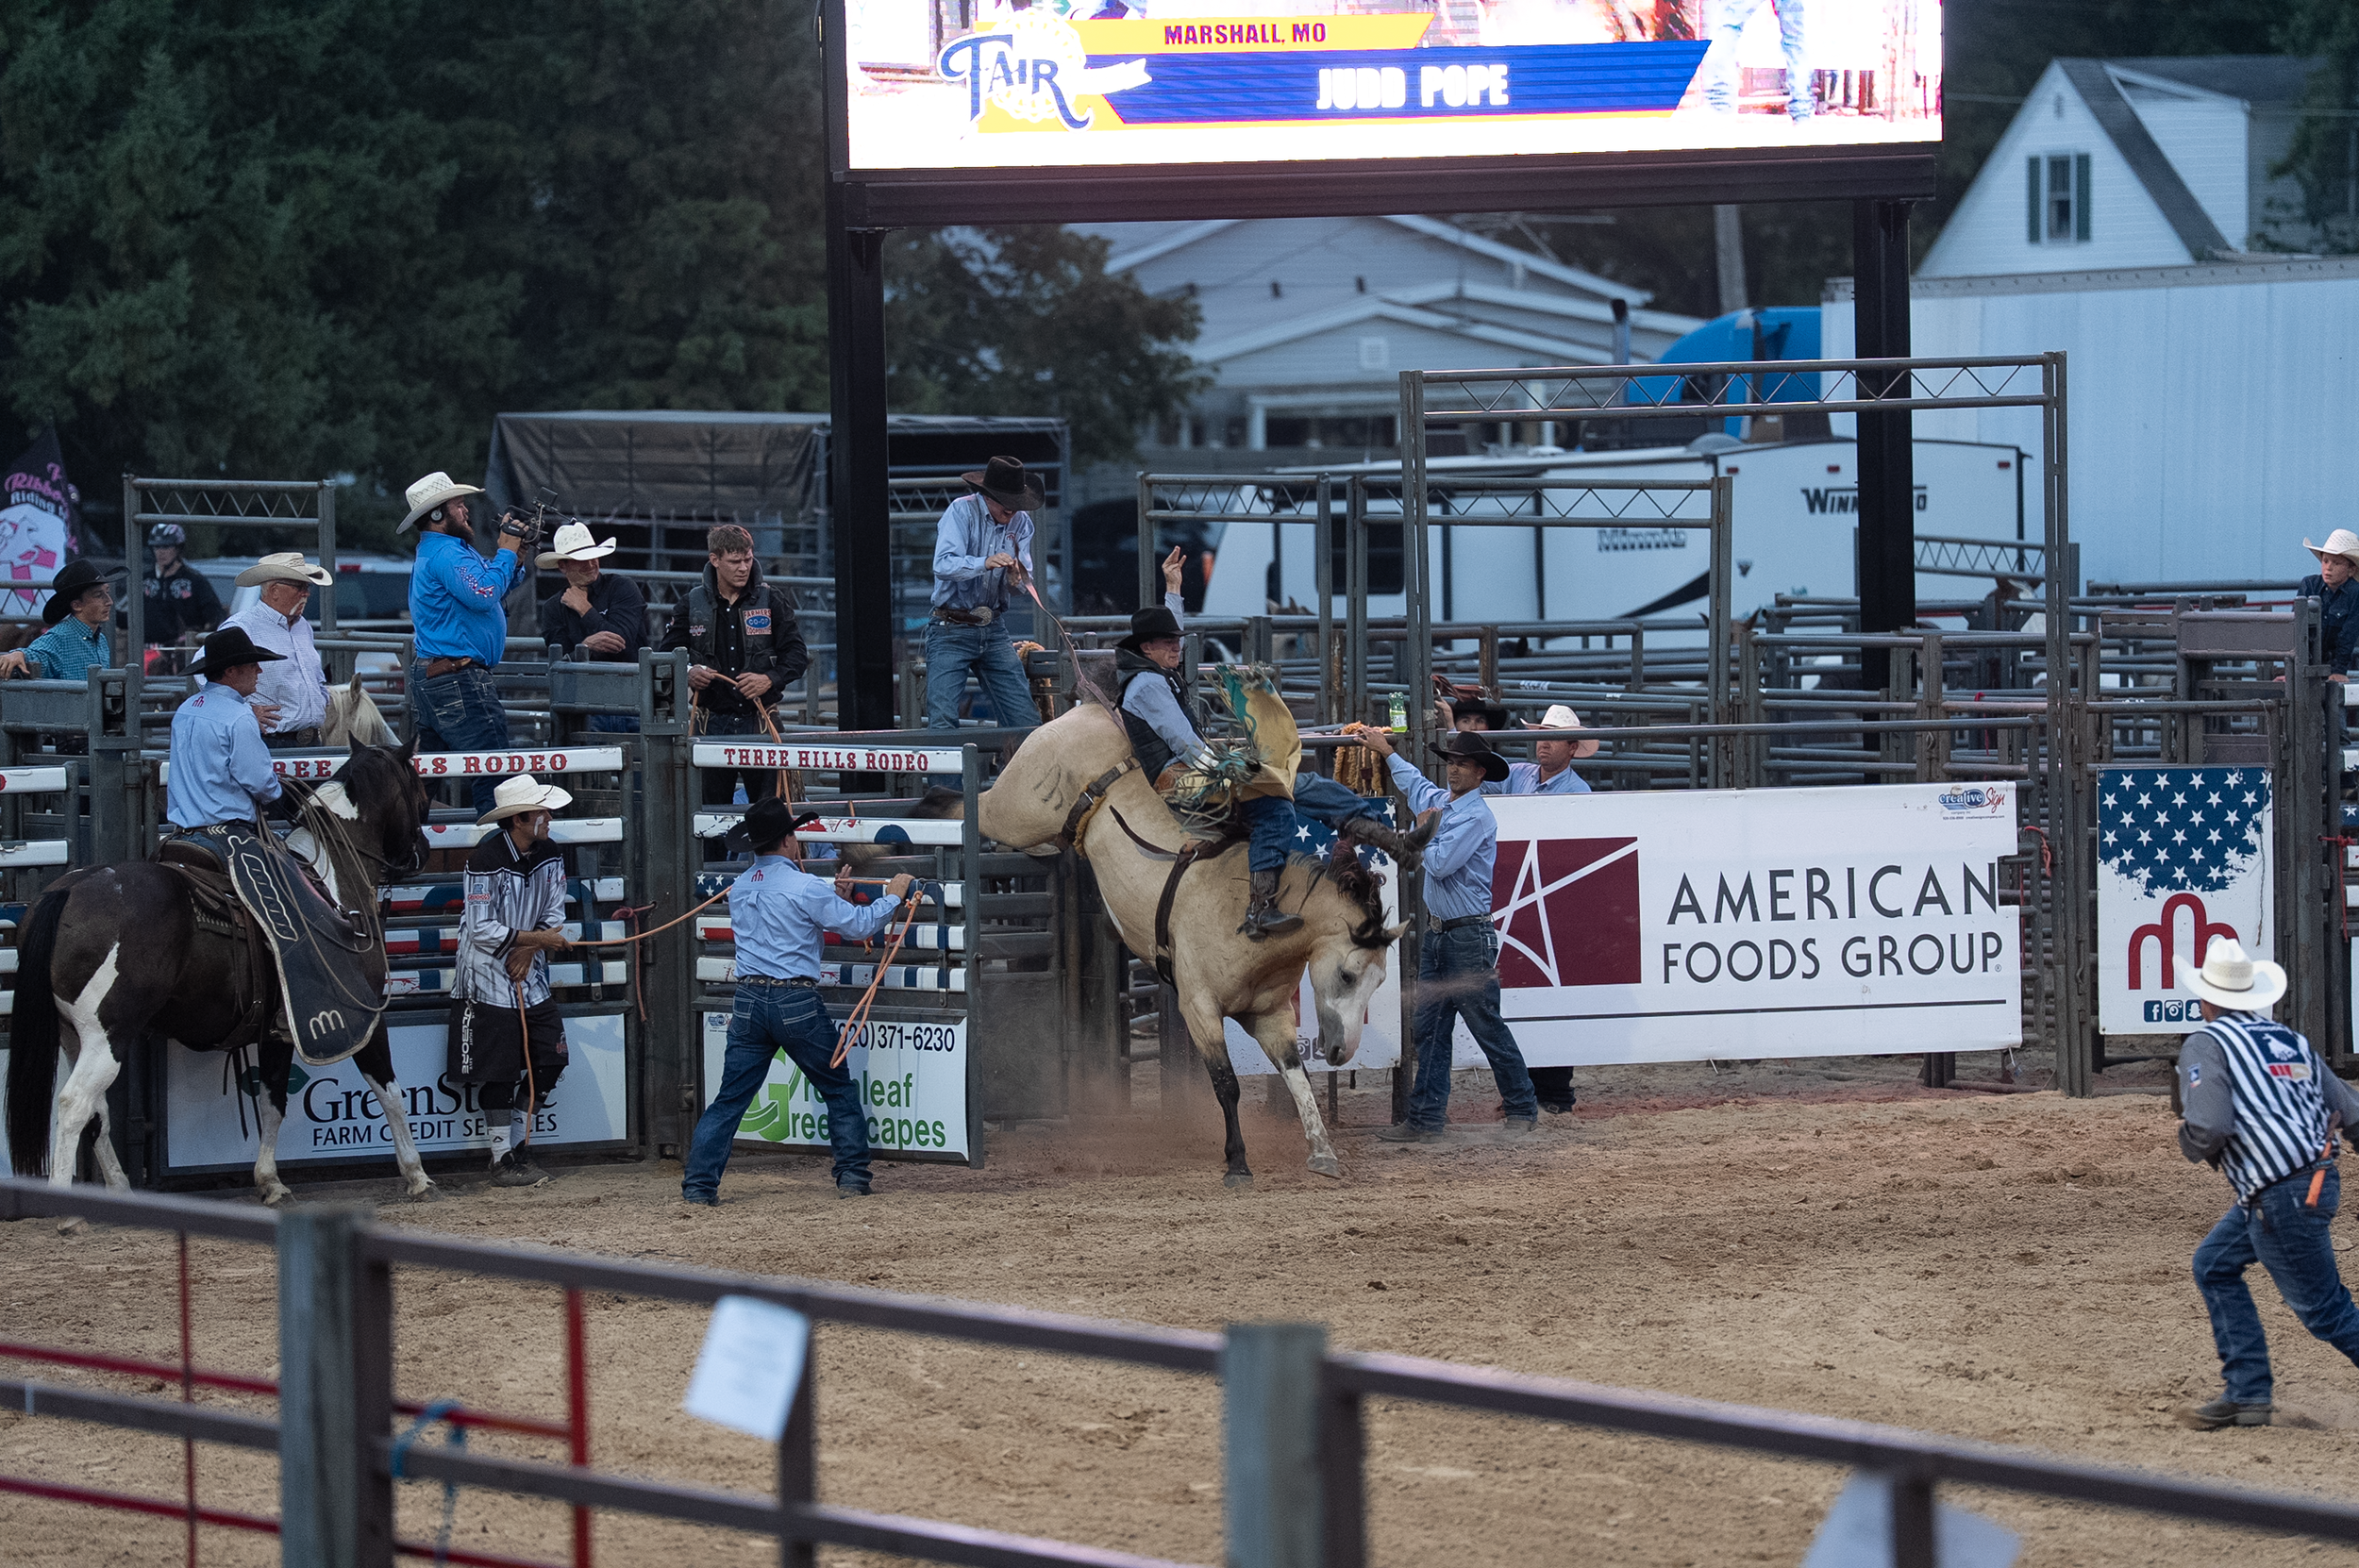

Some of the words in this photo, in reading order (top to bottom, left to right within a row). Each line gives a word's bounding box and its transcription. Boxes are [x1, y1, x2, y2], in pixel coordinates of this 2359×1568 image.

[1164, 24, 1285, 45] MARSHALL,
[1292, 23, 1326, 42] MO
[1315, 67, 1406, 109] JUDD
[1420, 64, 1510, 108] POPE
[273, 759, 332, 778] REE
[462, 753, 568, 775] RODEO
[724, 748, 789, 767] THREE
[798, 751, 857, 770] HILLS
[865, 752, 929, 771] RODEO
[1666, 861, 1998, 926] AMERICAN
[1663, 938, 1821, 984] FOODS
[1841, 931, 2002, 978] GROUP
[312, 1126, 372, 1146] FARM
[379, 1120, 455, 1143] CEDIT
